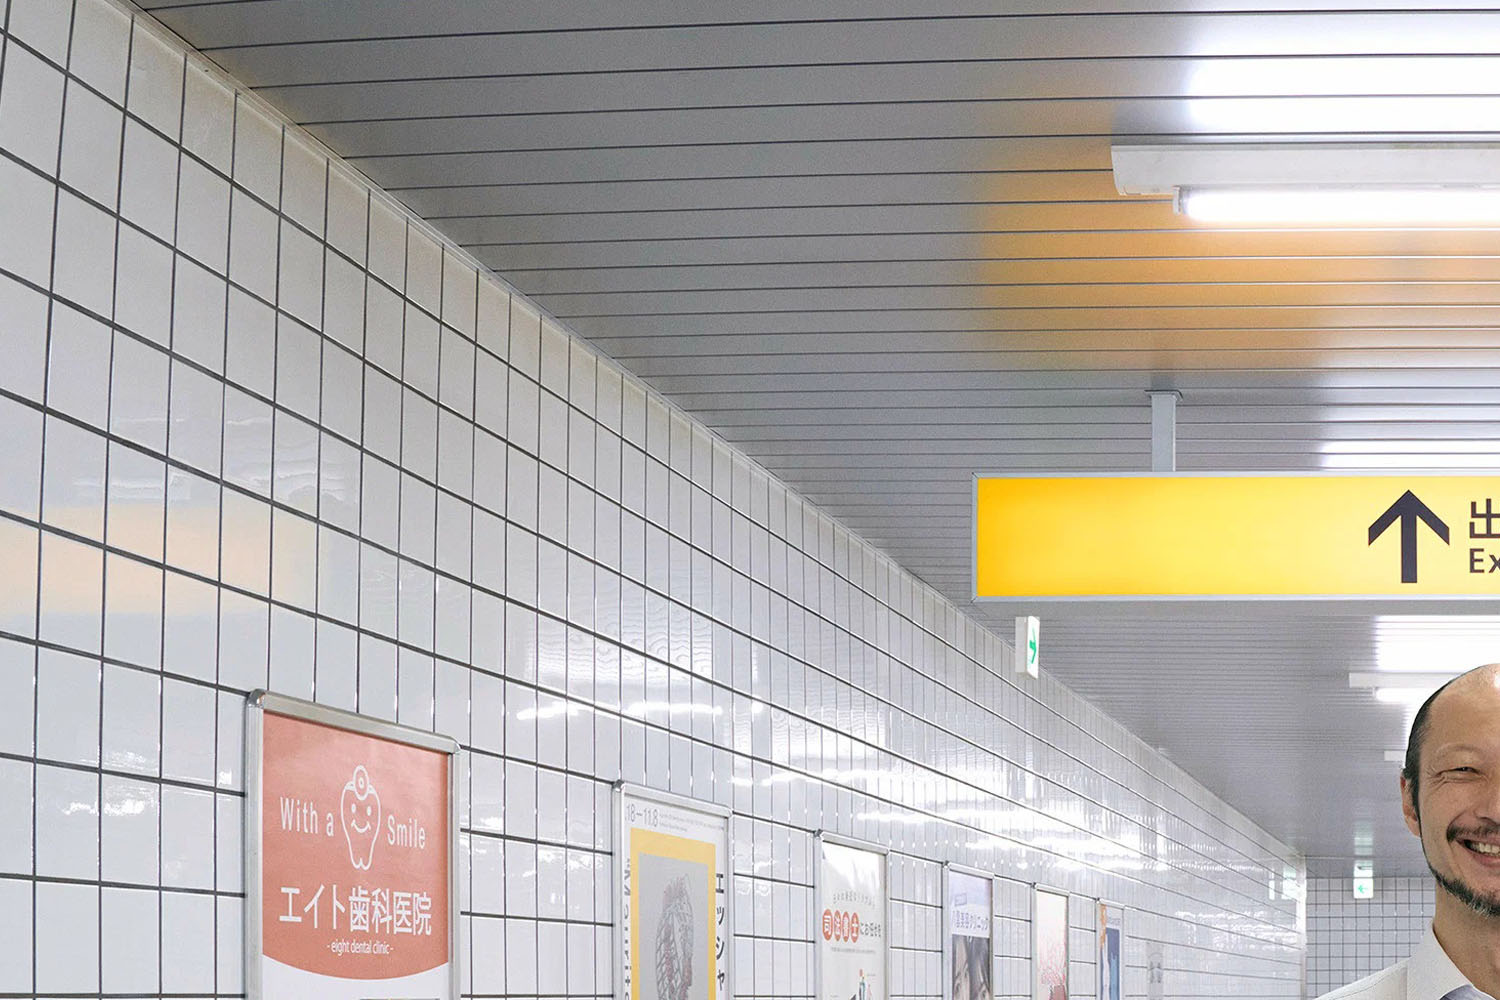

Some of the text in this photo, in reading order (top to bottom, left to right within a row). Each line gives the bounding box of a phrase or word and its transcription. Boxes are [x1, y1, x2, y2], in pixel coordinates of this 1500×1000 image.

[280, 796, 426, 849] With a Smile
[279, 884, 432, 936] エイト歯科医院
